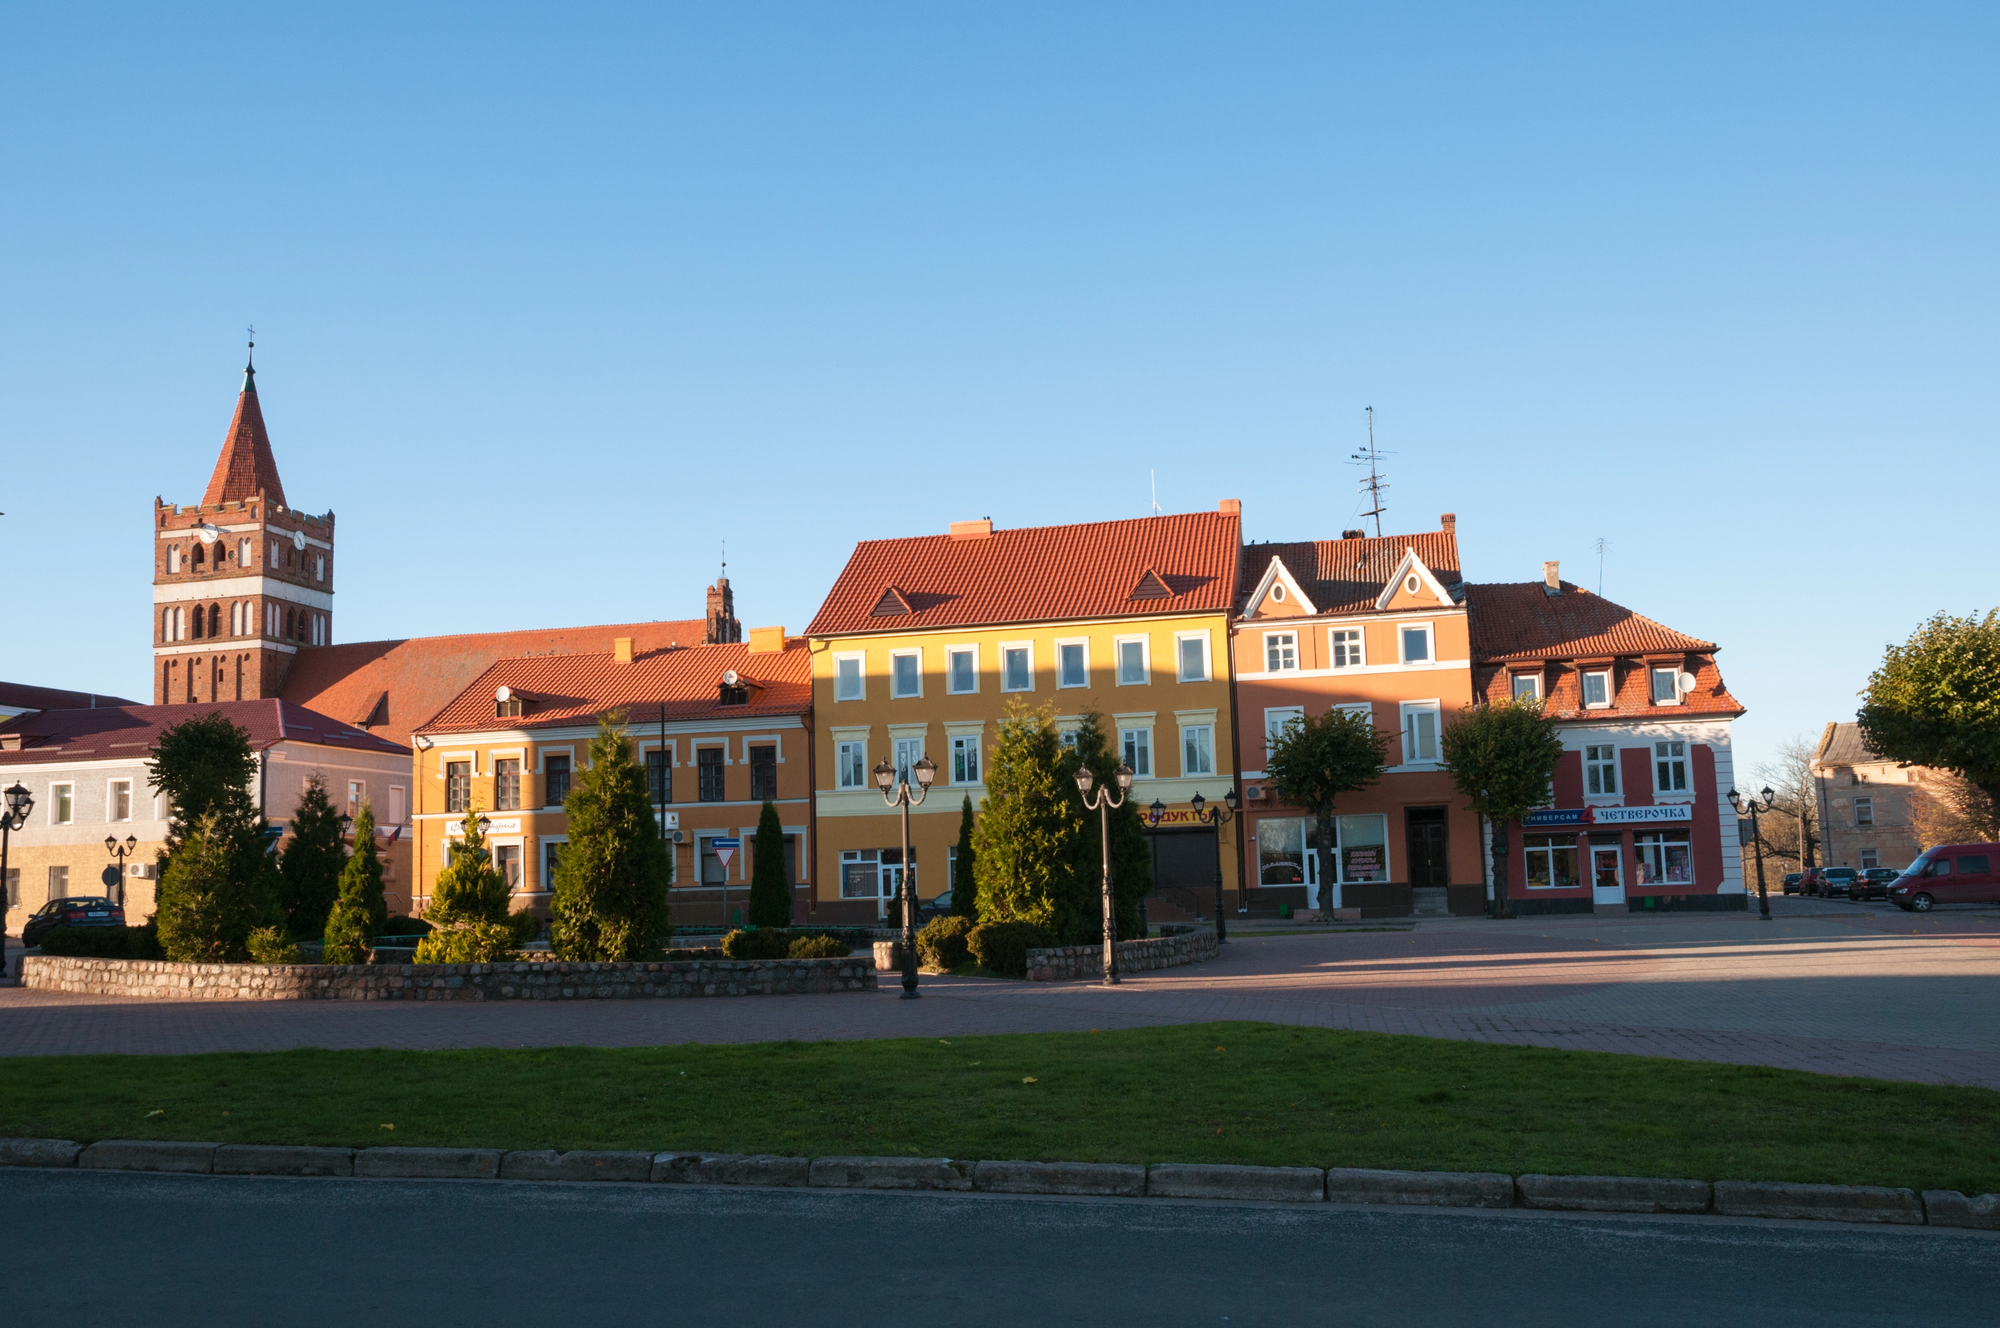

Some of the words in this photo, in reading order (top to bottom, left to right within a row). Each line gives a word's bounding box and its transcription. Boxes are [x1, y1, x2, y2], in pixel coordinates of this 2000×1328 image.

[1139, 810, 1214, 824] РОДУКТЫ
[1580, 804, 1597, 825] 4
[1600, 807, 1687, 821] ЧЕТВЕРОЧКА
